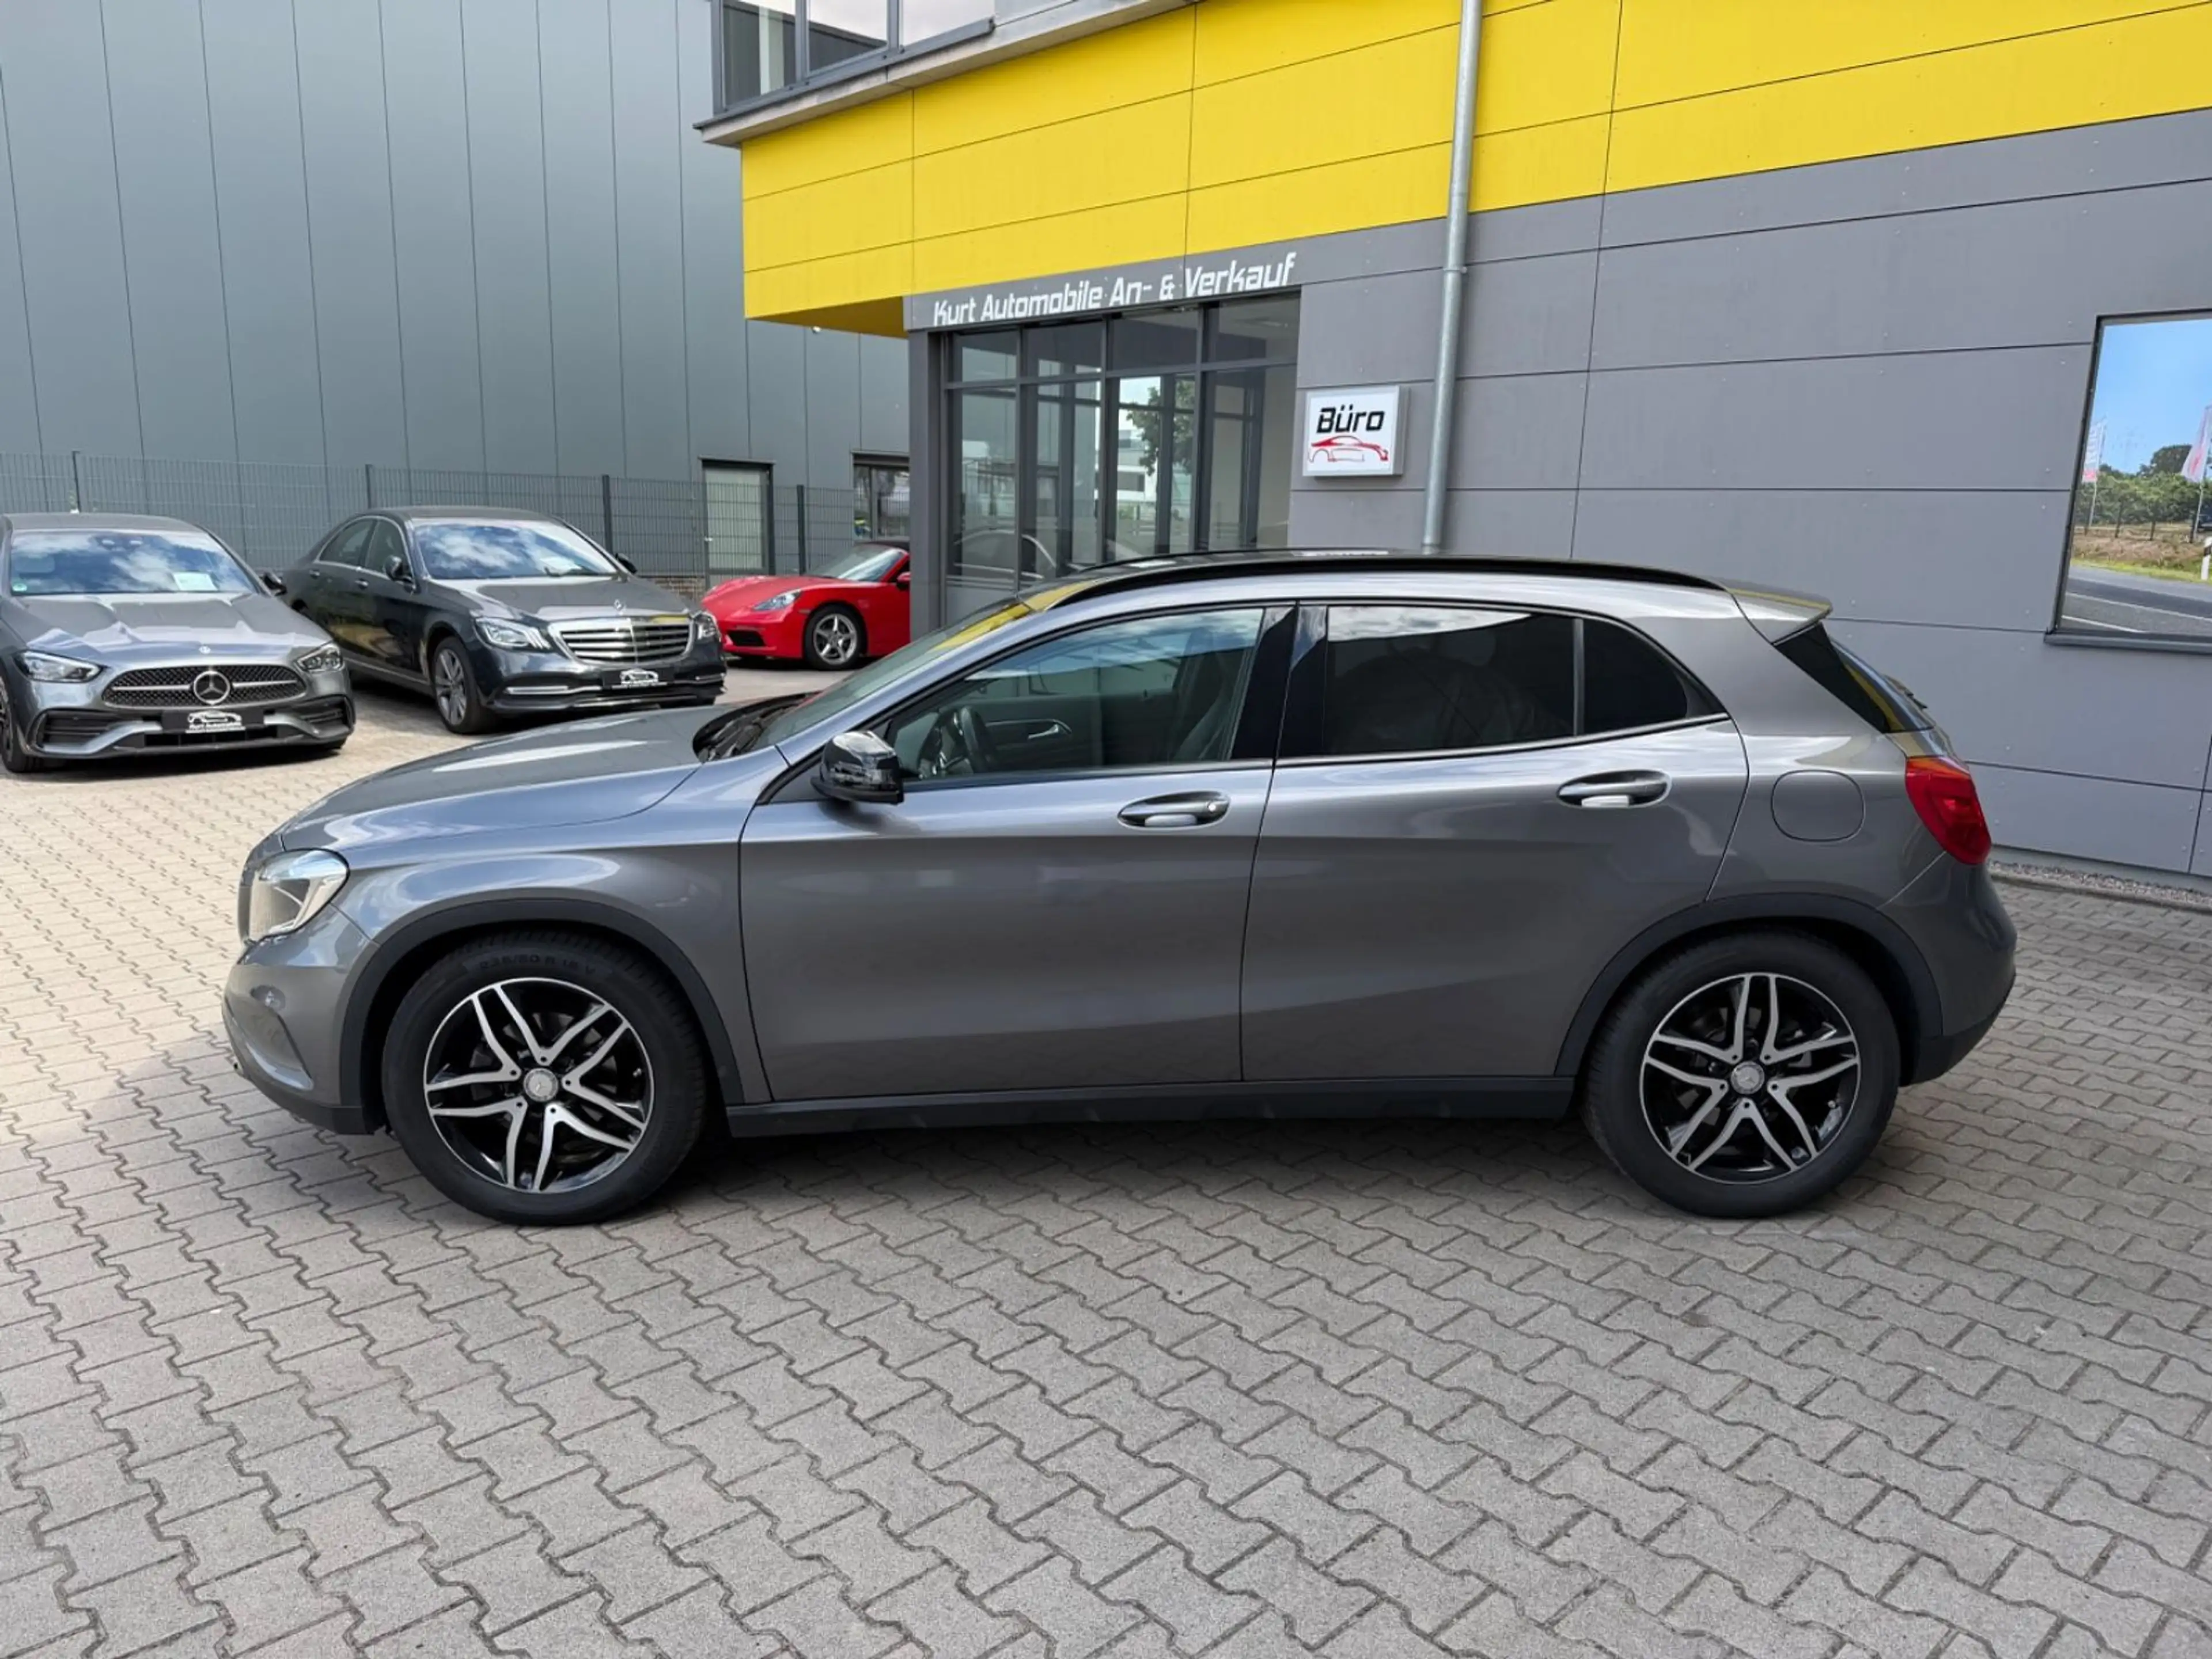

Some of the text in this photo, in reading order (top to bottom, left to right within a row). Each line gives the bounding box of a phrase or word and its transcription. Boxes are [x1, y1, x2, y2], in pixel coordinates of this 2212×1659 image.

[933, 252, 1297, 327] Kurt Automobile An- & Verkauf
[1316, 404, 1385, 433] Büro
